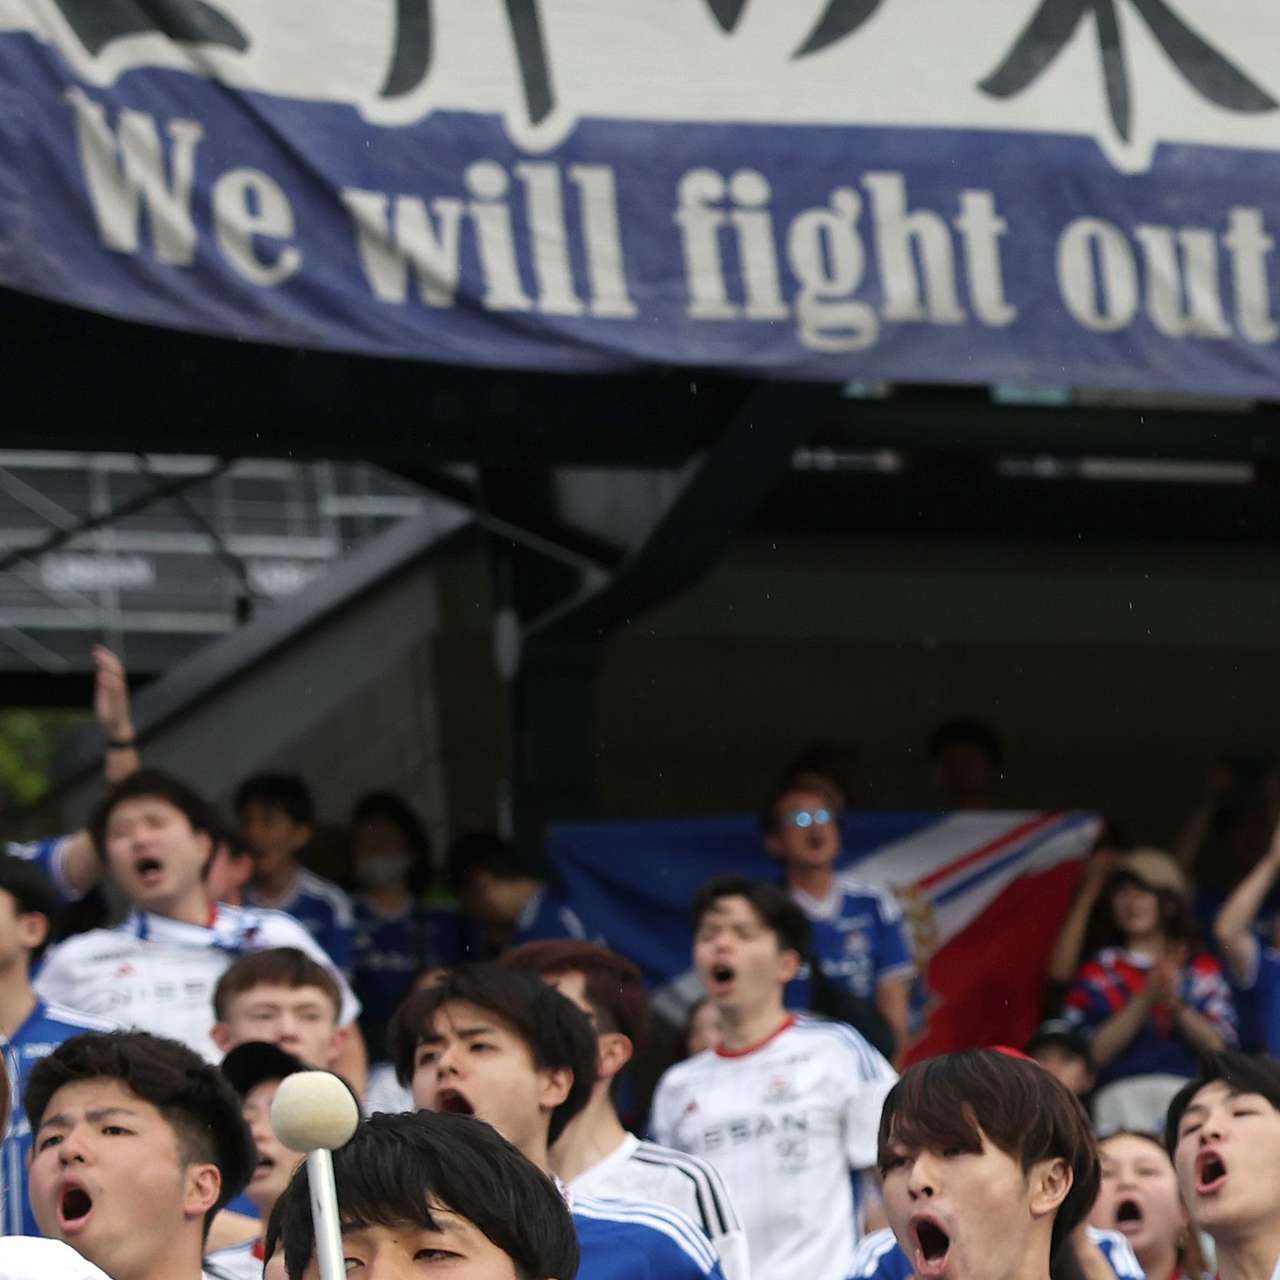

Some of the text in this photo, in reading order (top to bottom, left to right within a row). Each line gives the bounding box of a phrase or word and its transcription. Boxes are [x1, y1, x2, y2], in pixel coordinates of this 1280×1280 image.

[62, 82, 301, 285] We
[341, 158, 637, 320] will
[673, 167, 1016, 354] fight
[1055, 203, 1280, 344] out
